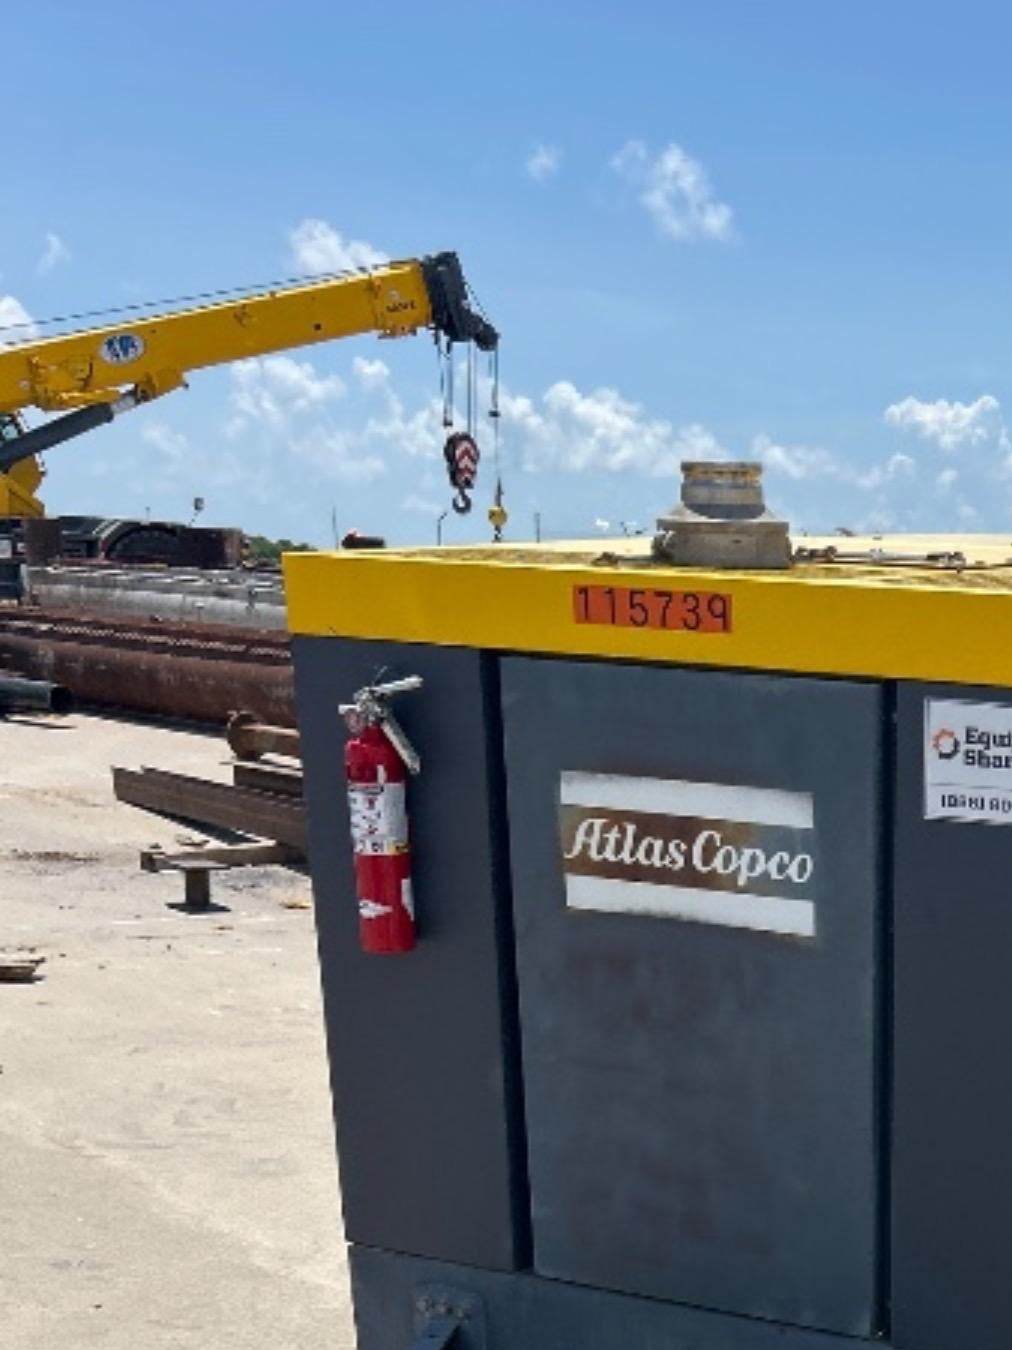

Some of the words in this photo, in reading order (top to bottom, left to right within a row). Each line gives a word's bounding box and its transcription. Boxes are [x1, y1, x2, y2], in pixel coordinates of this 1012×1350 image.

[578, 587, 729, 631] 115739
[563, 818, 688, 871] Atlas
[691, 830, 815, 887] Copco
